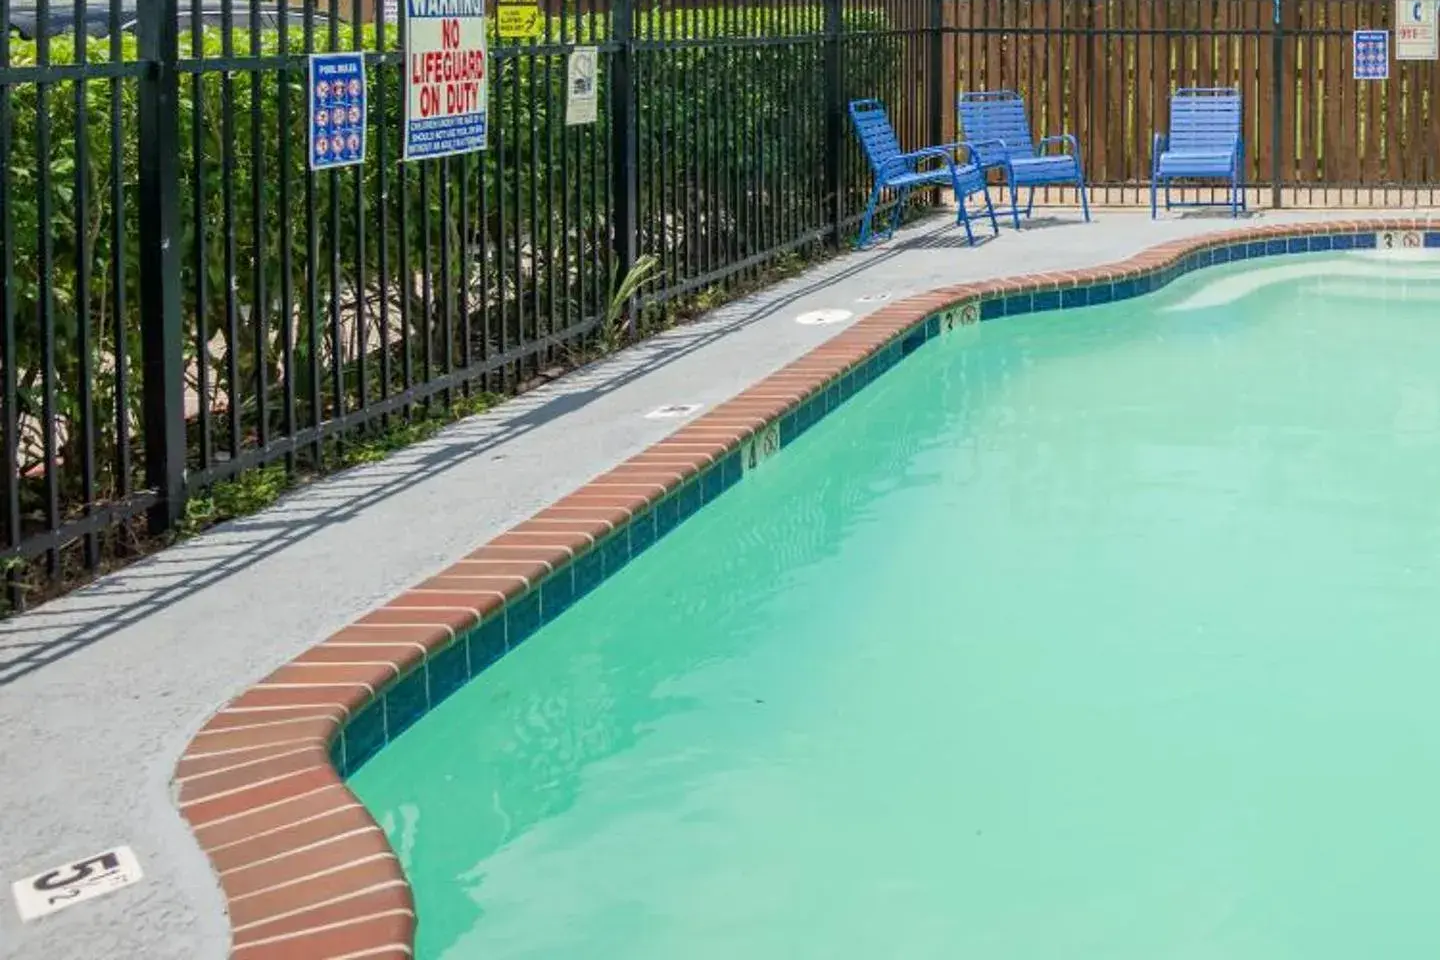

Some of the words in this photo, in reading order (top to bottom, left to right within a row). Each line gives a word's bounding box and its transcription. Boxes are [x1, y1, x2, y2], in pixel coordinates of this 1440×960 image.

[442, 19, 460, 50] NO
[412, 50, 483, 85] LIFEGUARD
[420, 85, 440, 117] ON
[447, 81, 479, 114] DUTY
